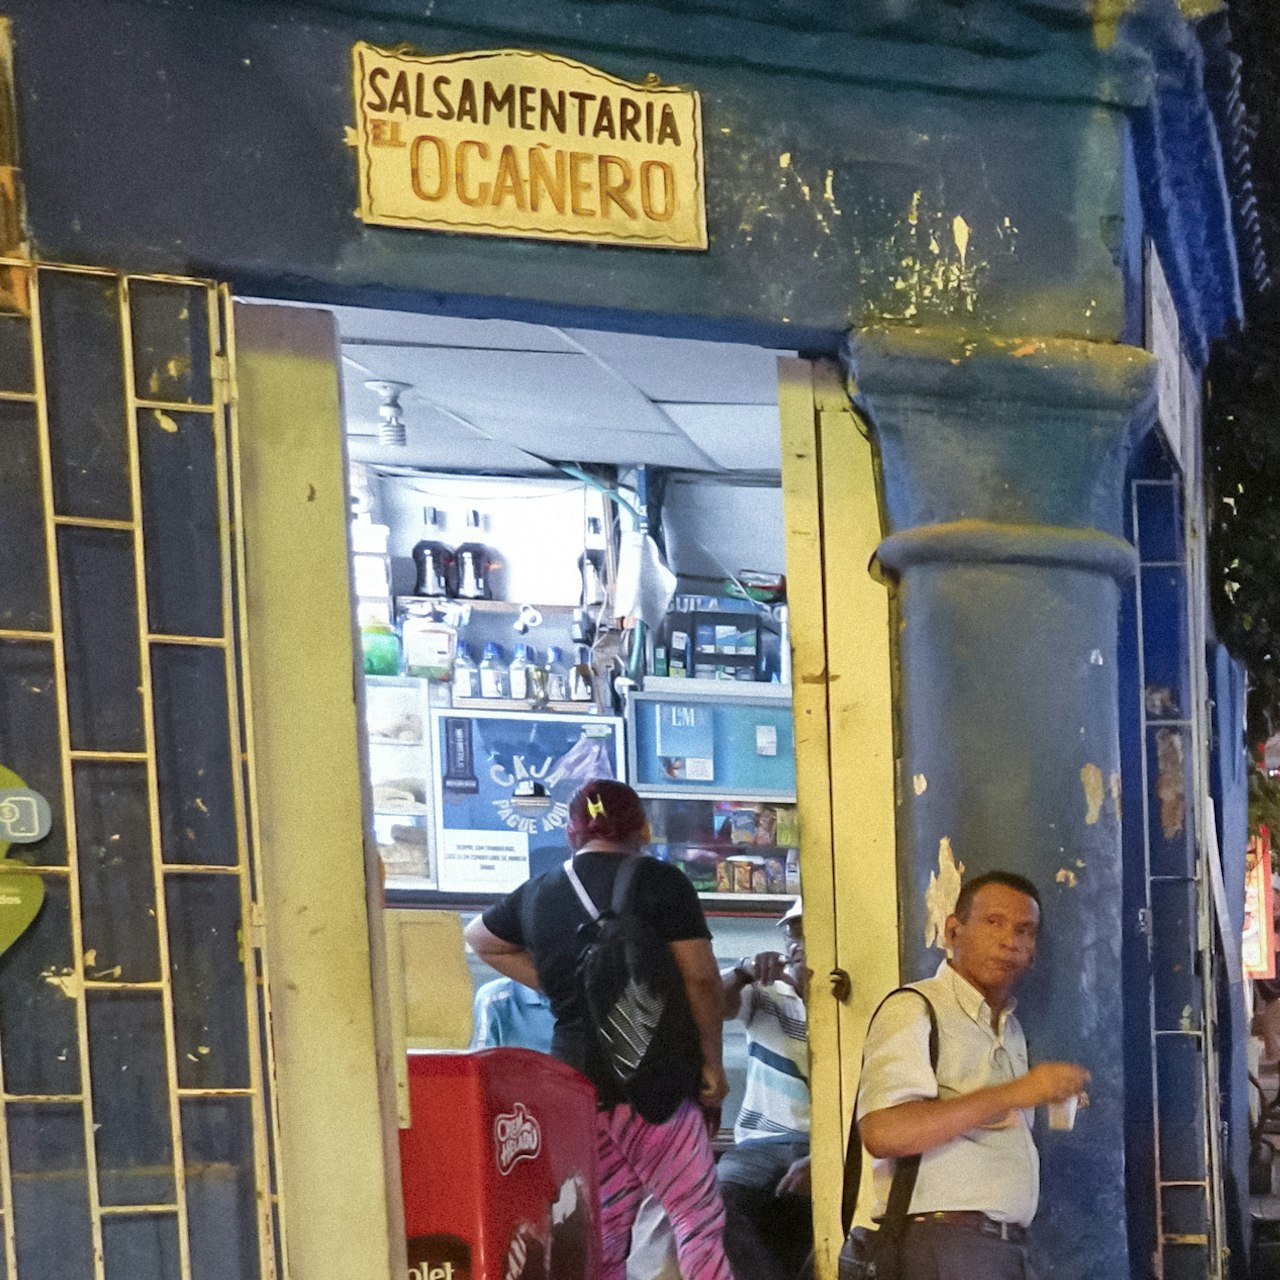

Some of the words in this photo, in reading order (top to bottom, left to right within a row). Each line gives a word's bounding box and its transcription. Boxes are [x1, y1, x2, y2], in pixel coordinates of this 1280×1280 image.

[366, 66, 682, 147] SALSAMENTARIA
[369, 118, 407, 148] EL
[409, 134, 676, 222] OCAÑERO
[489, 754, 567, 789] CAJA
[491, 799, 539, 835] PAGUE
